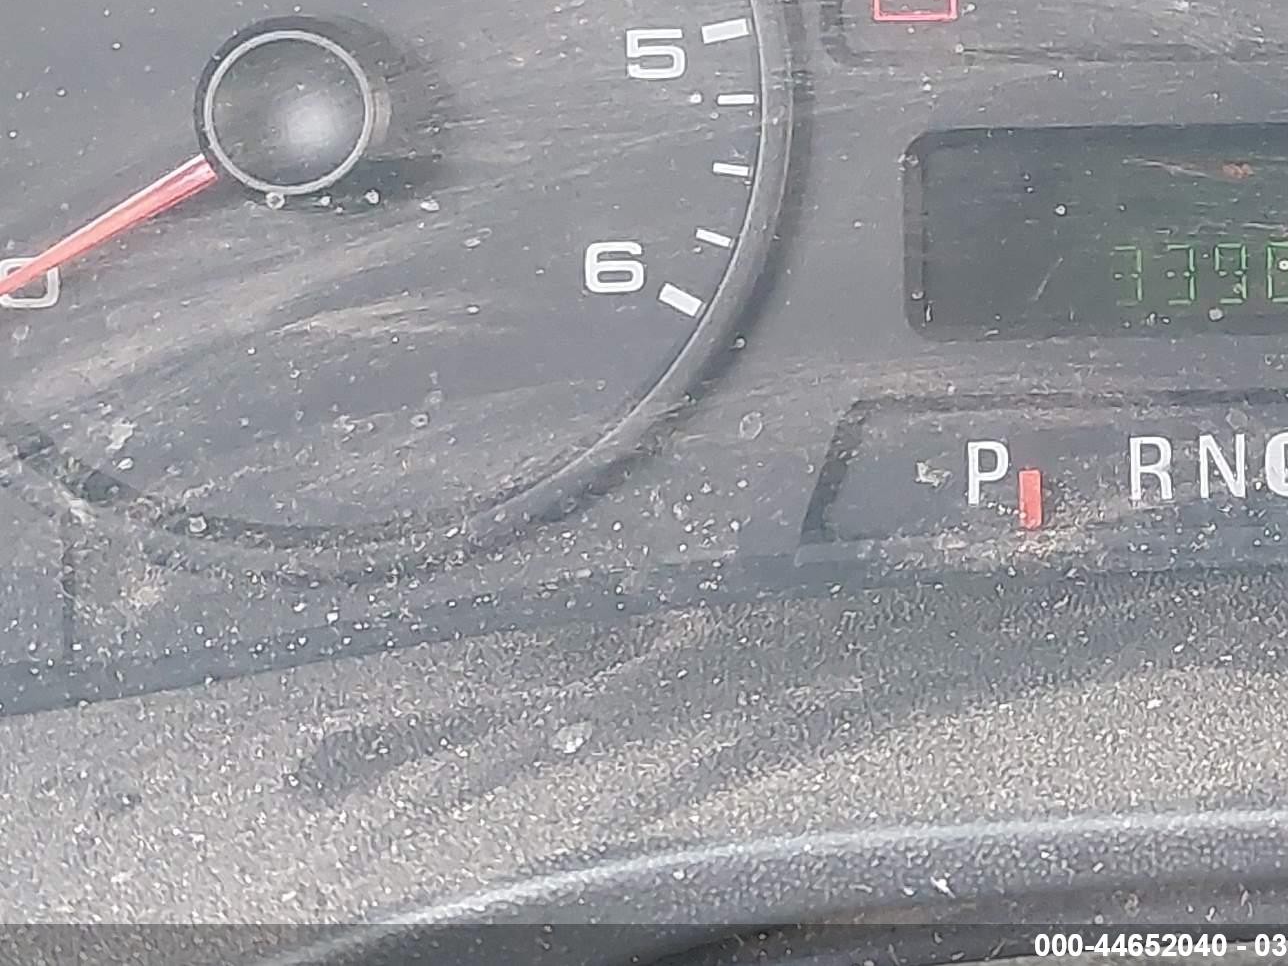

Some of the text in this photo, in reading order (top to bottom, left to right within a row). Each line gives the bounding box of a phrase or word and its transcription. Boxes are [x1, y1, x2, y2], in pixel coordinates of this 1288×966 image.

[626, 28, 687, 80] 5
[584, 241, 645, 294] 6
[966, 440, 1009, 505] P
[1129, 434, 1174, 500] R
[1199, 433, 1247, 499] N
